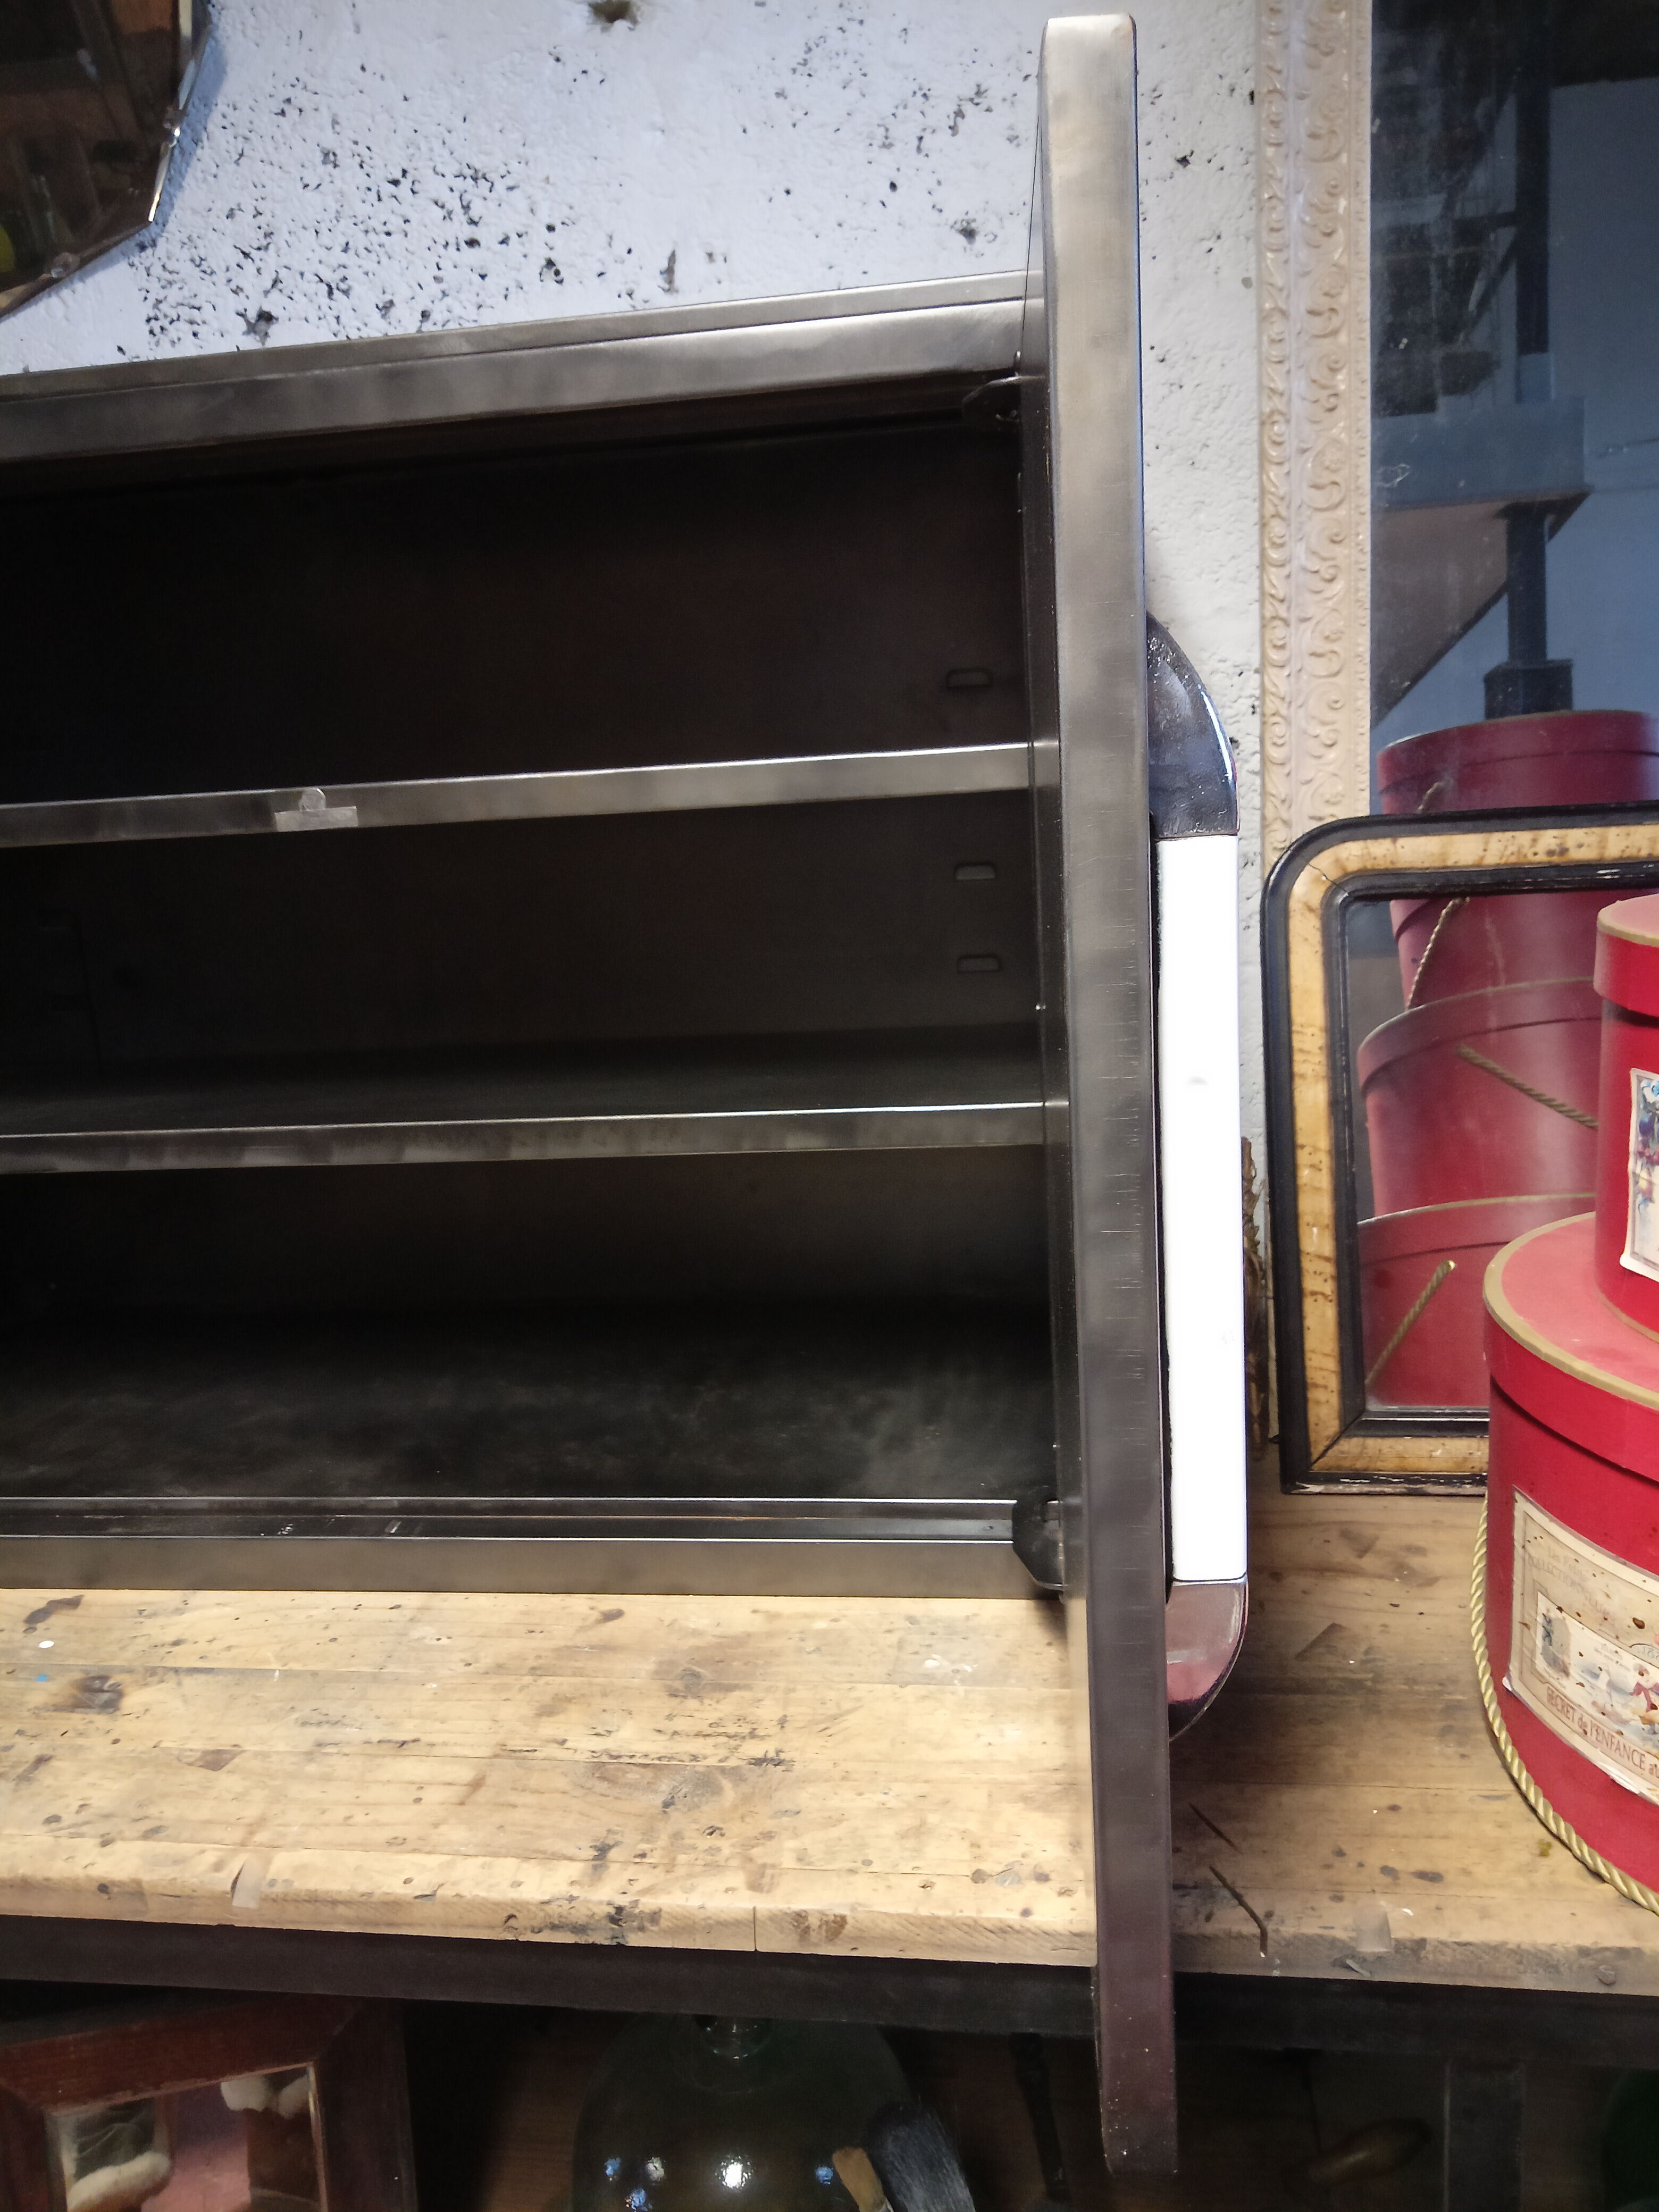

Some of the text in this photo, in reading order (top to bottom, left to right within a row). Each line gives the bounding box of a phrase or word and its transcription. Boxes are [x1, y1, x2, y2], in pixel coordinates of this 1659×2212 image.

[1547, 1686, 1577, 1723] SECRET
[1578, 1713, 1588, 1729] de
[1590, 1720, 1646, 1771] l'ENFANCE
